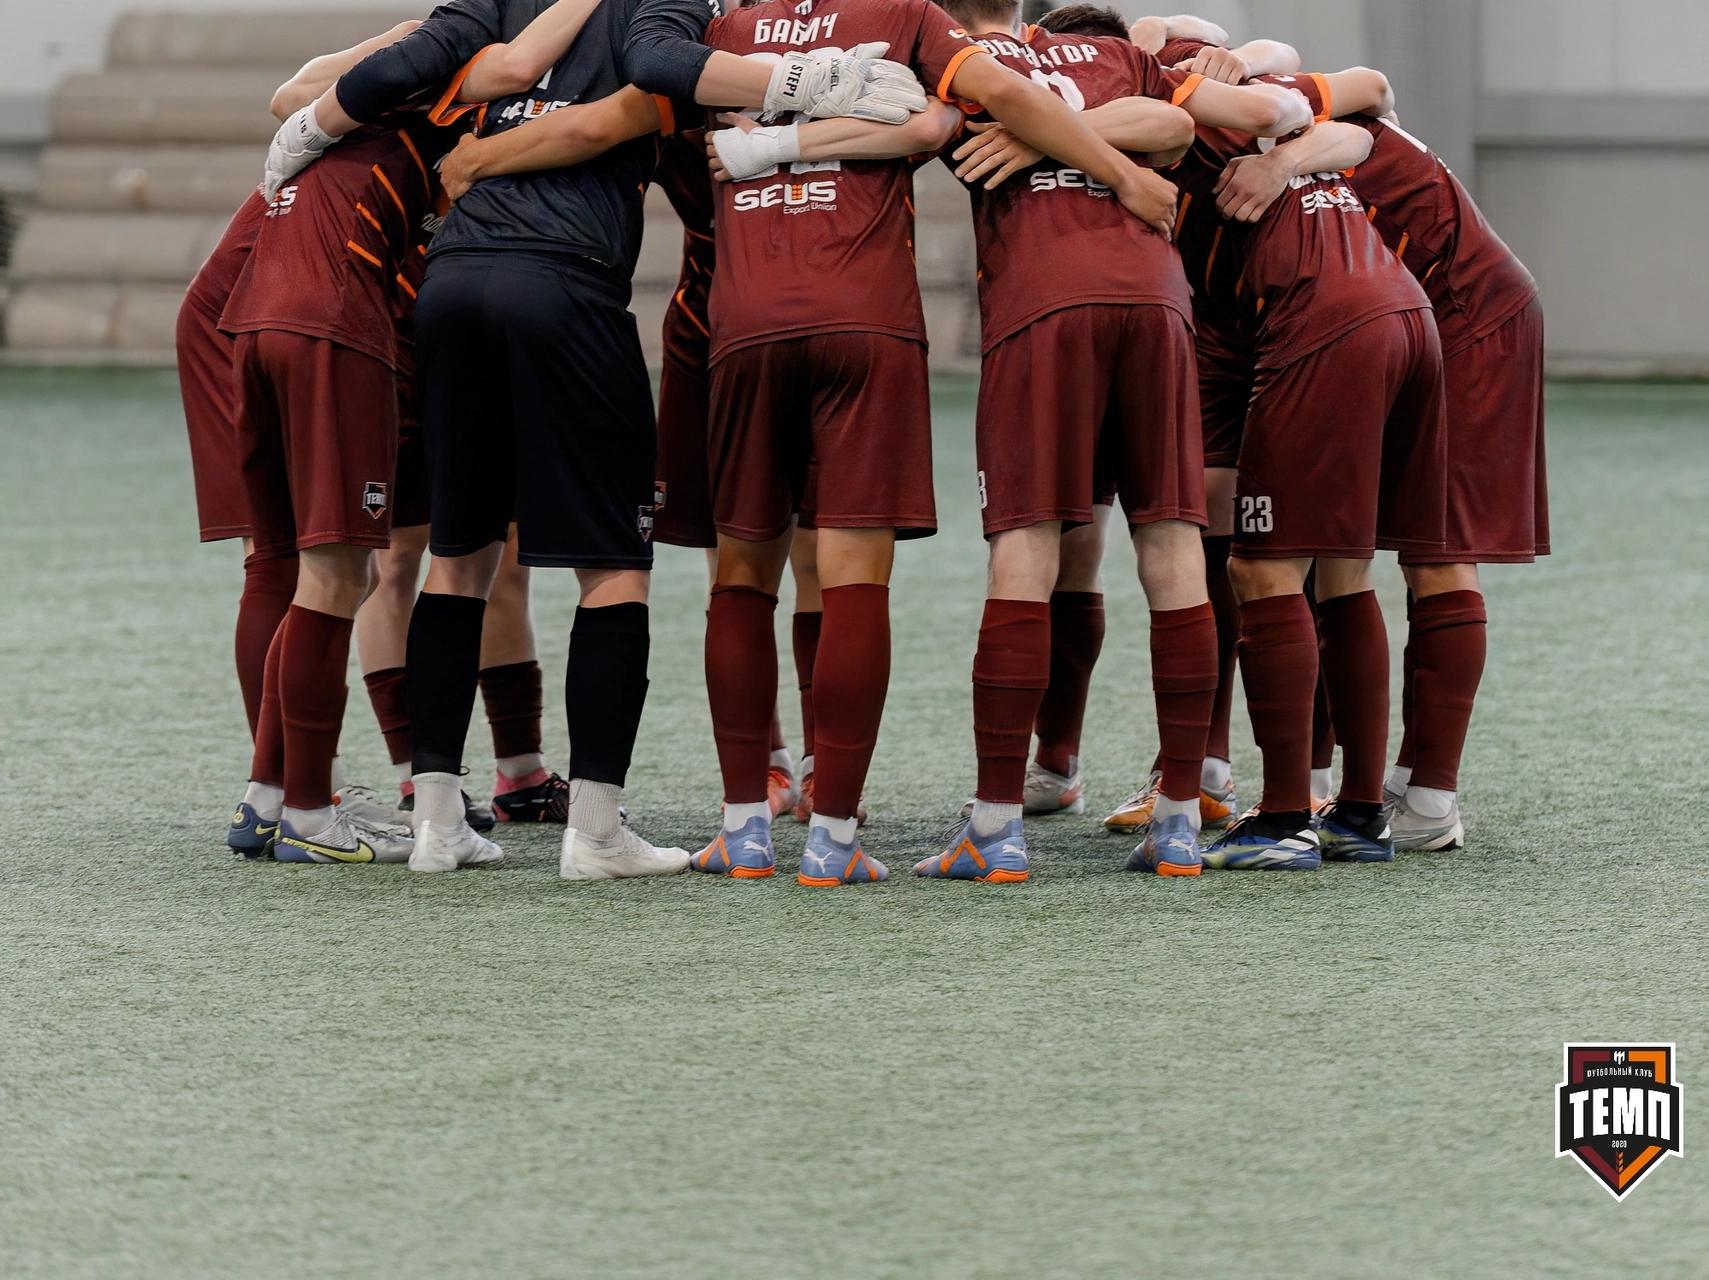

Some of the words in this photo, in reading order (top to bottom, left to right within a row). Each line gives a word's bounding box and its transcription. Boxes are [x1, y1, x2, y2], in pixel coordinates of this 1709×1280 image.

[733, 180, 837, 211] SEUS
[1030, 168, 1110, 193] SEU
[1241, 495, 1273, 532] 23
